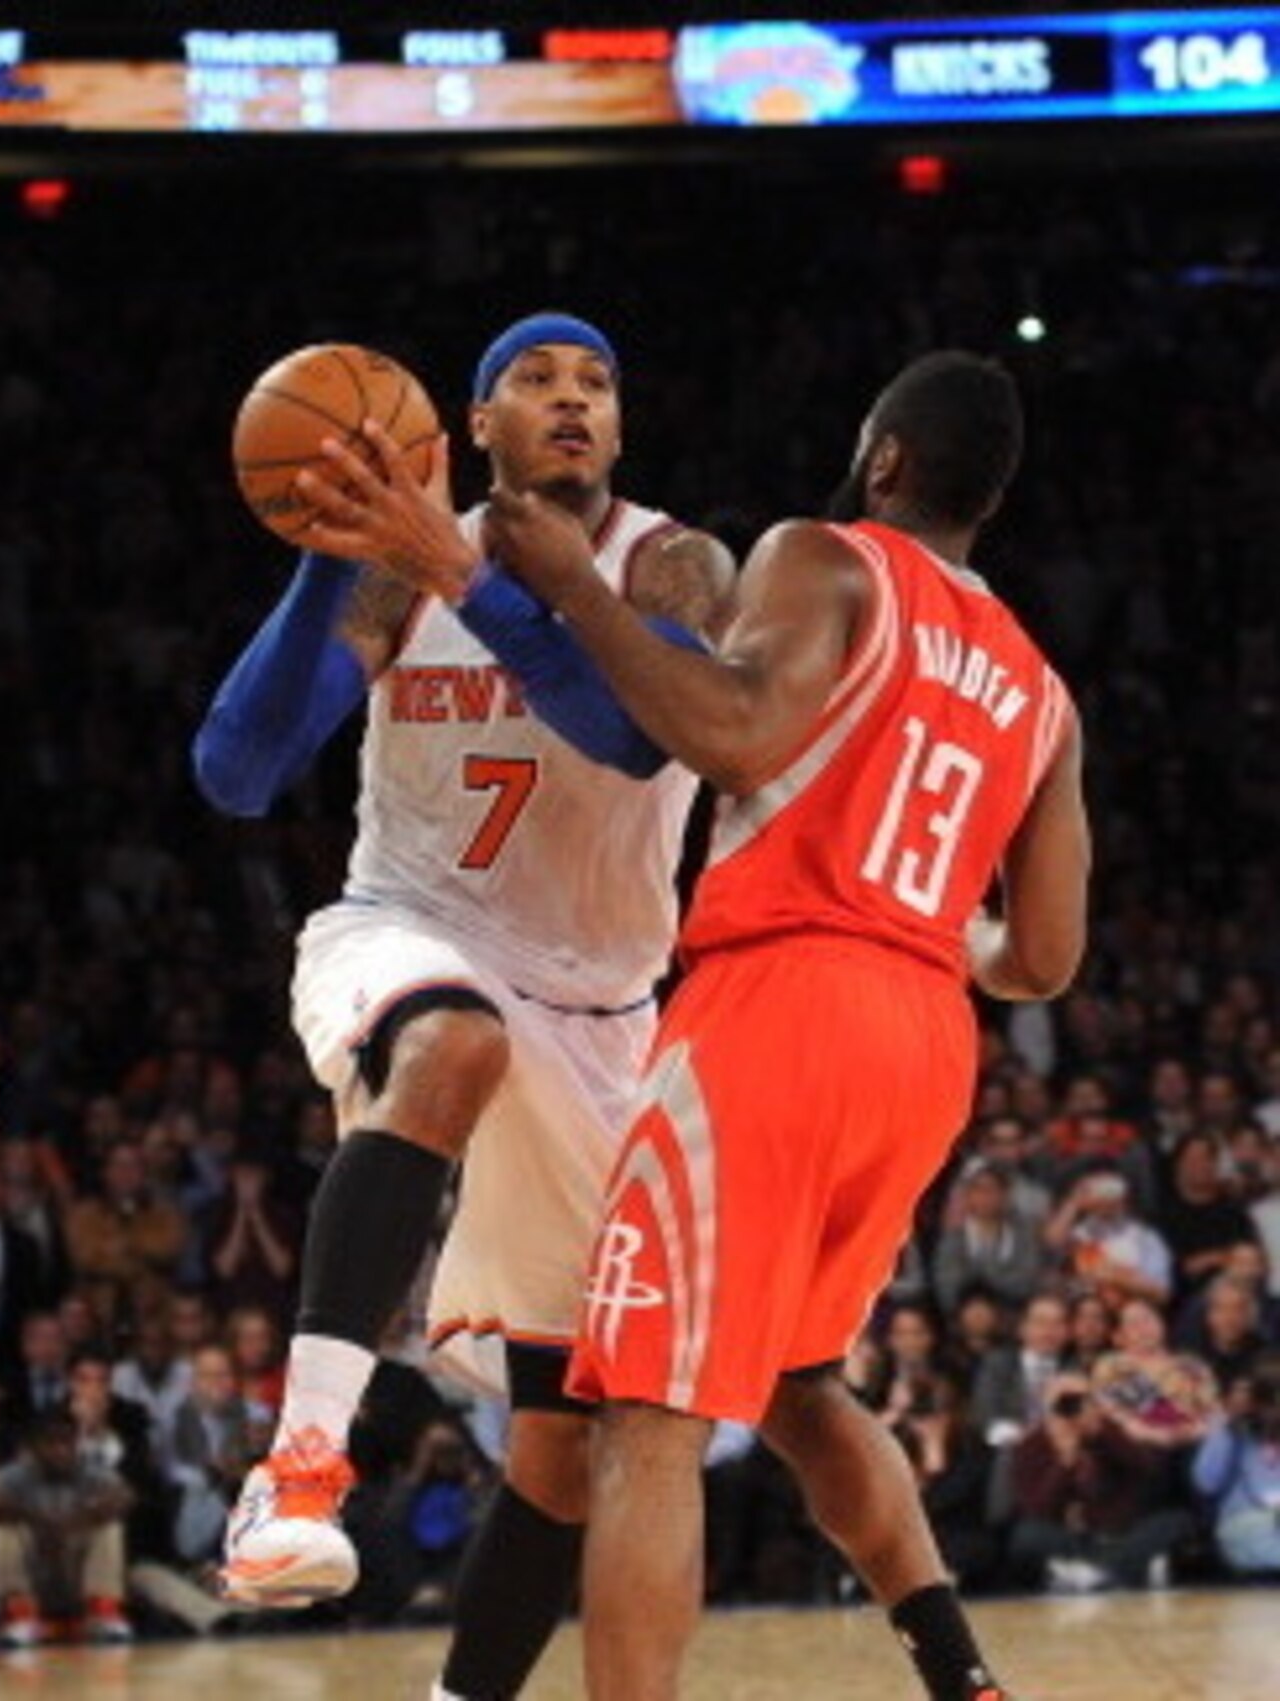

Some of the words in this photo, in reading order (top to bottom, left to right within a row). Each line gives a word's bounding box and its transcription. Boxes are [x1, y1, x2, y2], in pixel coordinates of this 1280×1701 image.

[892, 40, 1051, 94] KNICKS
[1140, 33, 1269, 91] 104
[457, 754, 538, 869] 7
[860, 716, 983, 917] 13
